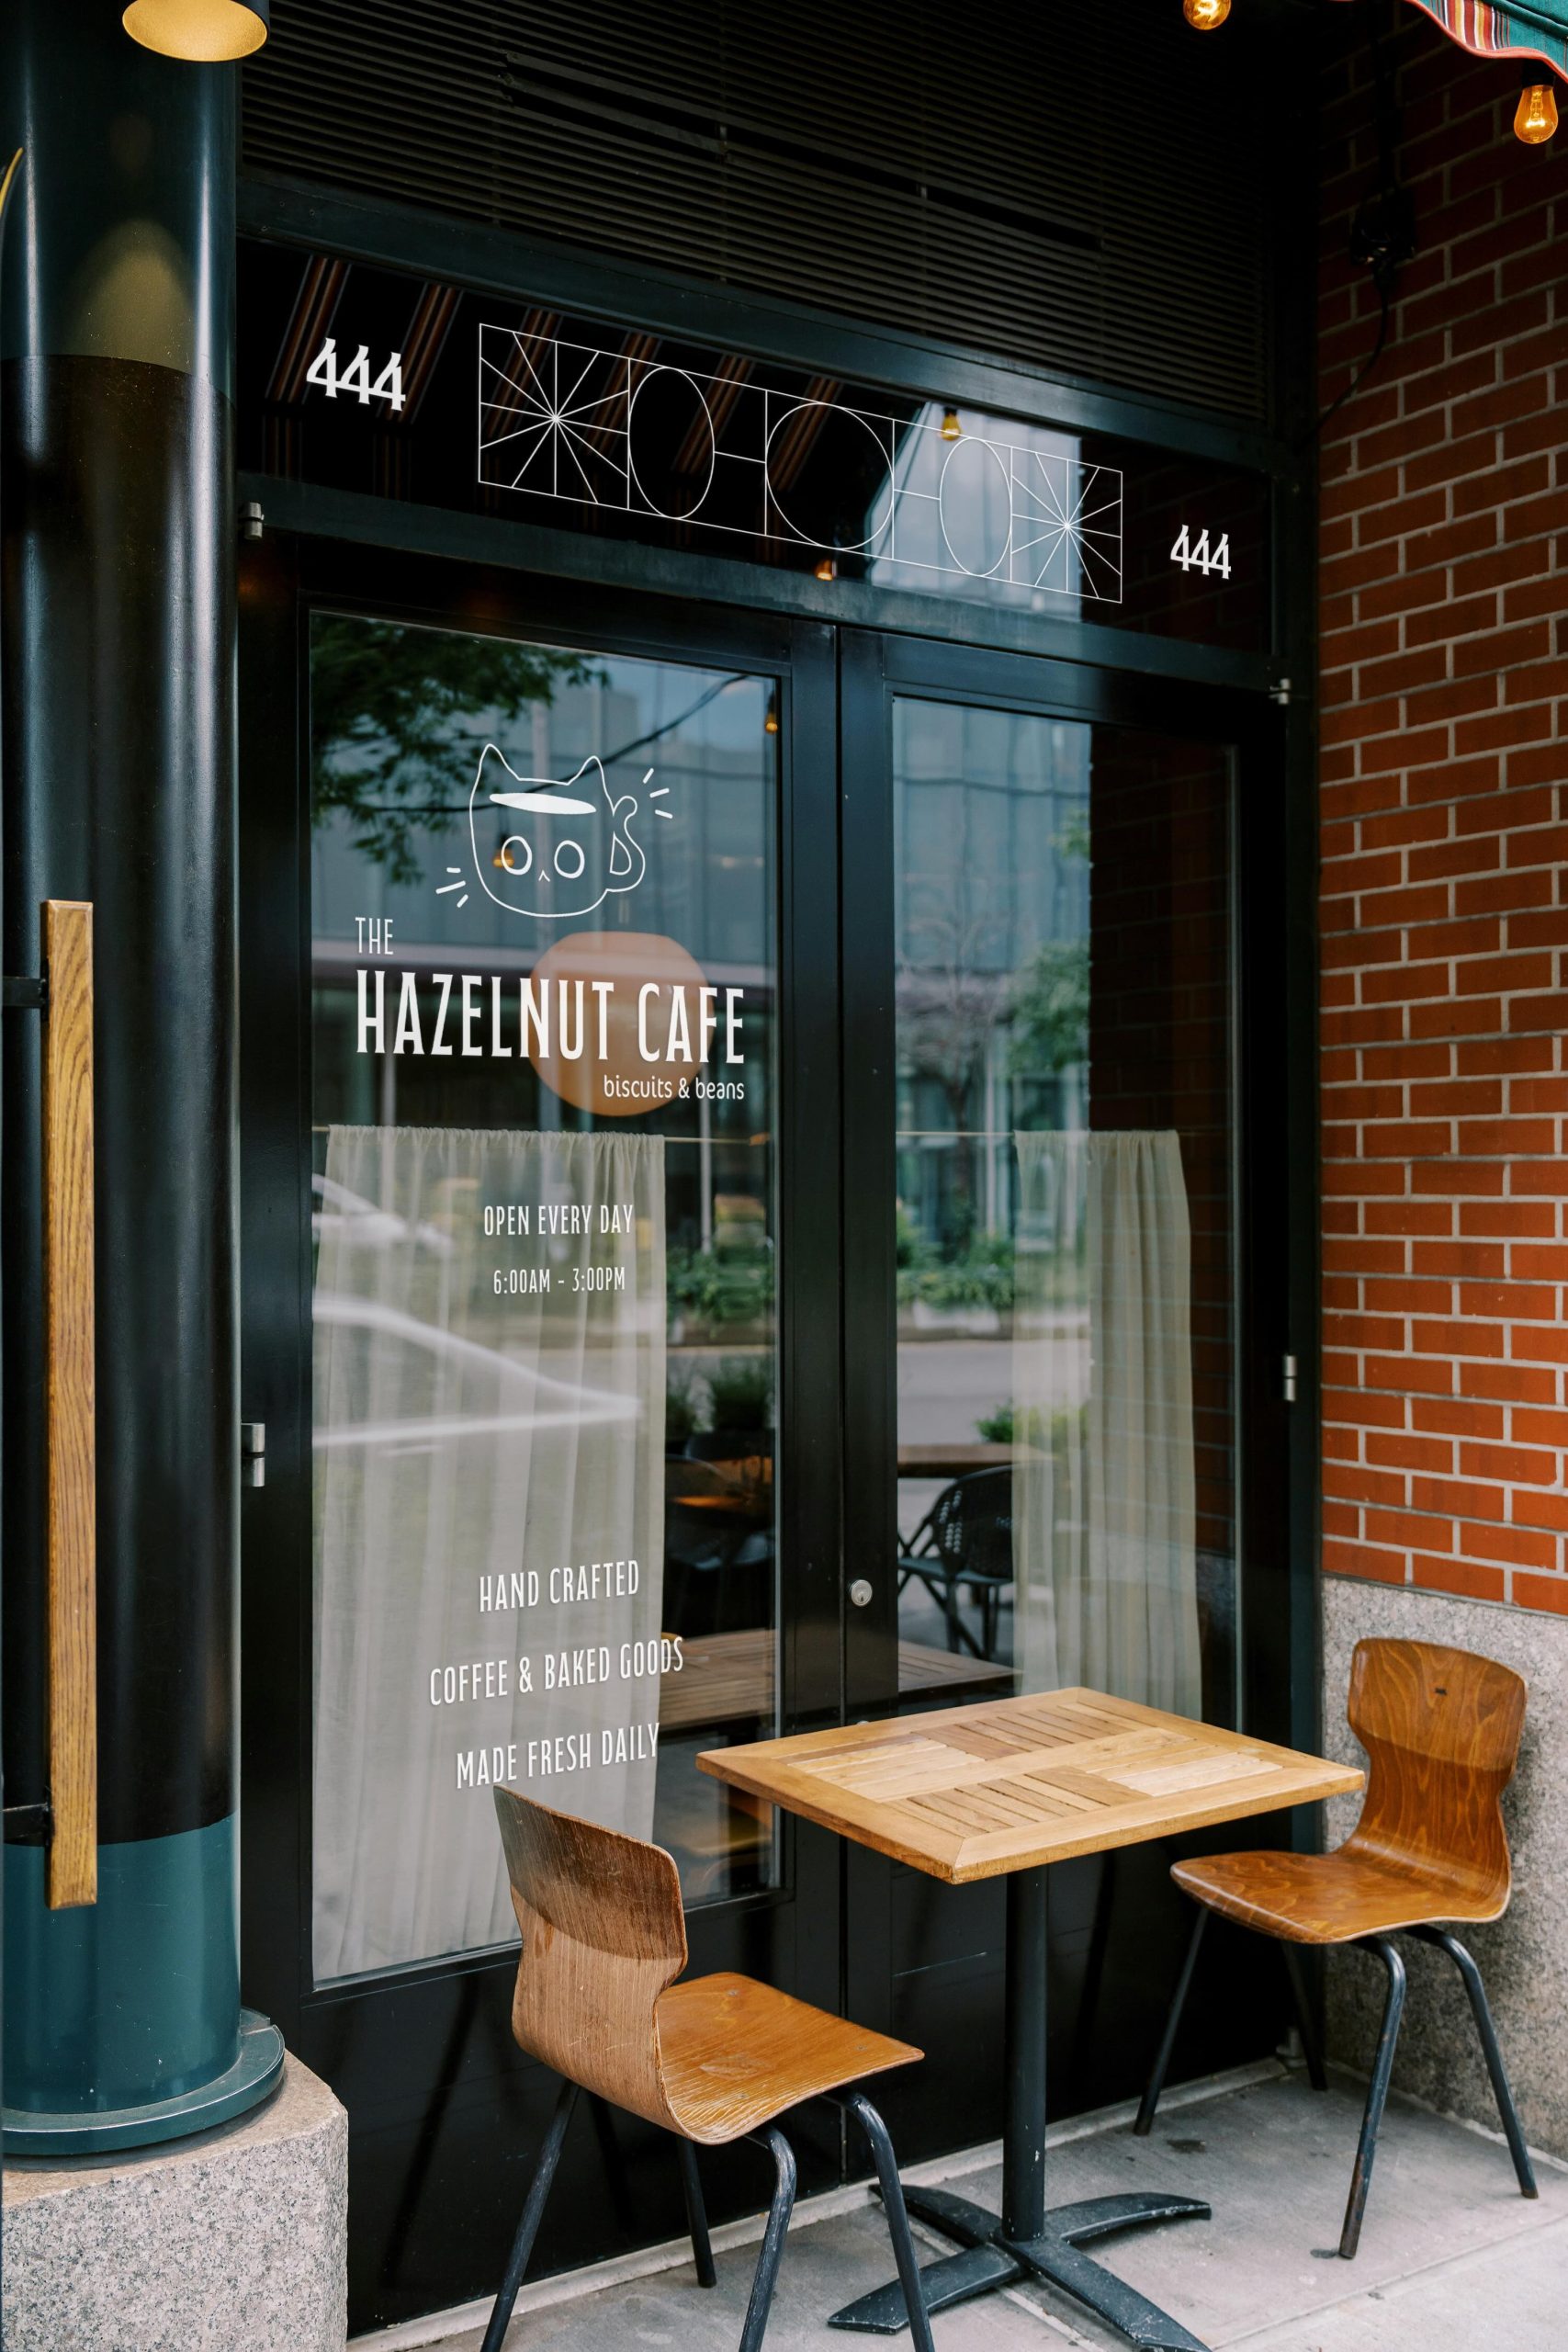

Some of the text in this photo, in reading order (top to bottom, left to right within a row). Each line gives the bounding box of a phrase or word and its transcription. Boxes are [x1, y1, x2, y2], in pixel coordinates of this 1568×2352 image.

[307, 338, 406, 411] 444
[1170, 525, 1232, 579] 444
[355, 917, 393, 955] THE
[357, 970, 744, 1063] HAZELNUT CAFE
[604, 1075, 745, 1100] biscuits & beans
[484, 1204, 634, 1235] OPEN EVERY DAY
[494, 1269, 550, 1294] 6:00AM
[572, 1267, 626, 1292] 3:00PM
[480, 1560, 639, 1611] HAND CRAFTED
[431, 1636, 683, 1705] COFFEE & BAKED GOODS
[457, 1723, 660, 1789] MADE FRESH DAILY
